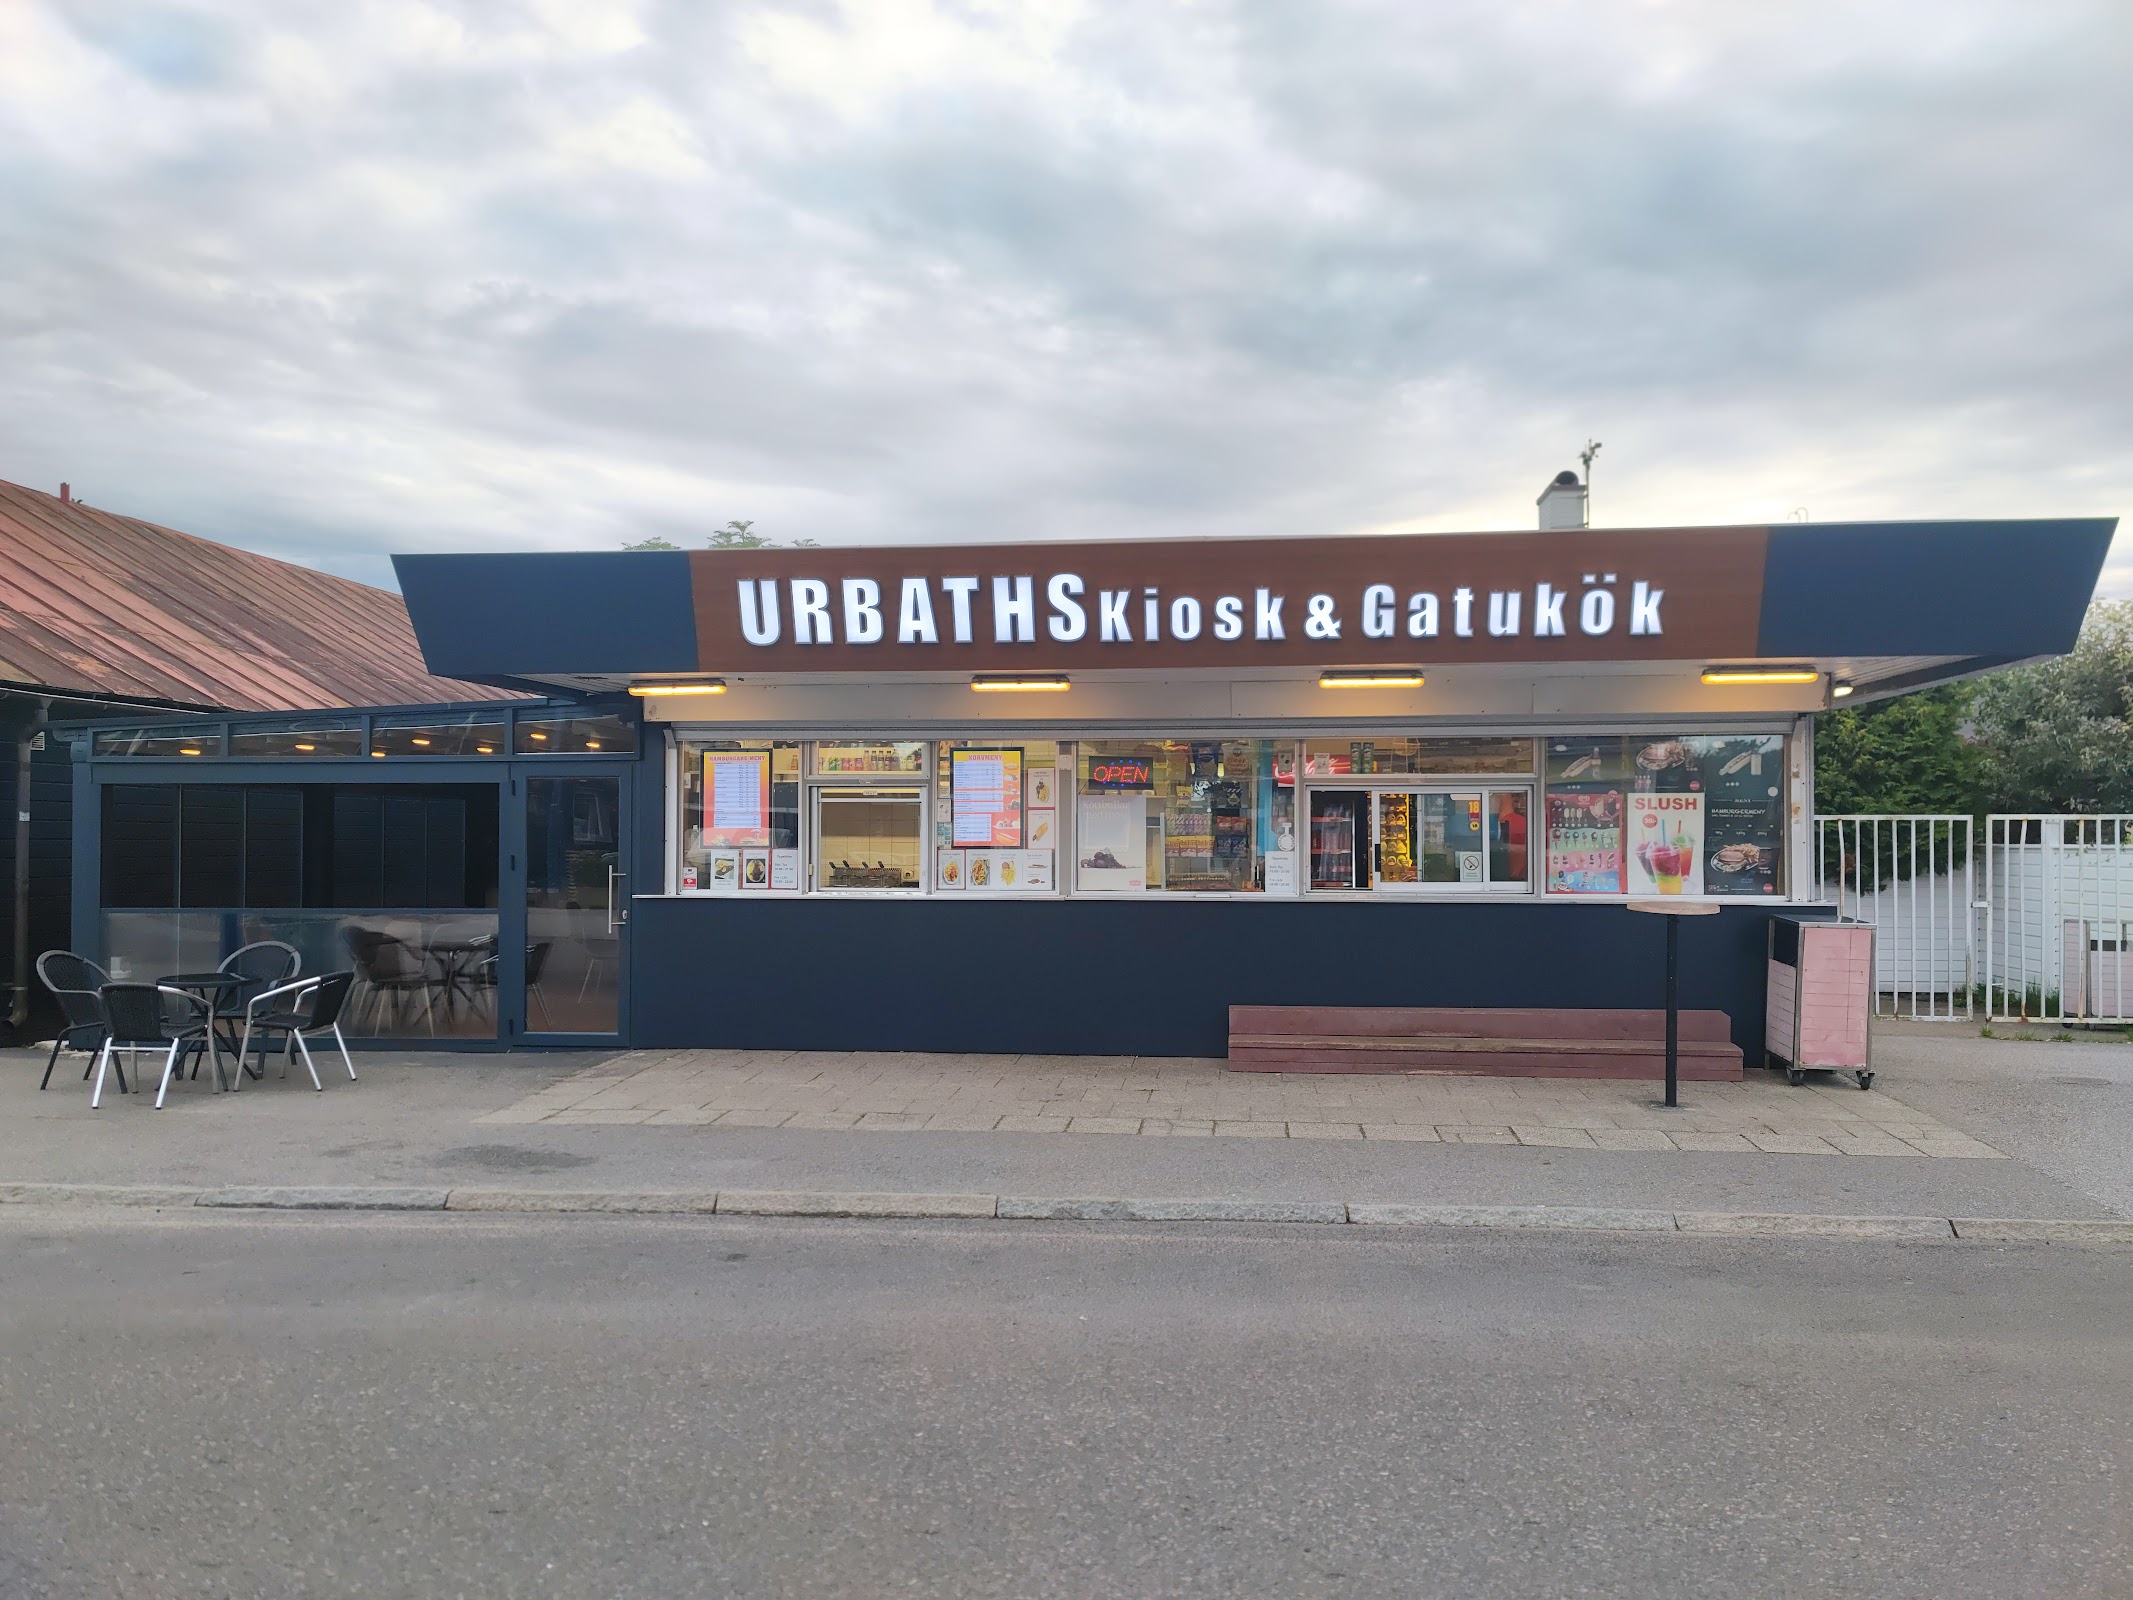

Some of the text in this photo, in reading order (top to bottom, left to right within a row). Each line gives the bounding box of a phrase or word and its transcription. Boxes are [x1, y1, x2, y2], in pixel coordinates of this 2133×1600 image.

[737, 572, 1666, 647] URBATHS Kiosk & Gatukök
[1093, 765, 1149, 783] OPEN
[1468, 800, 1480, 813] 18
[1634, 797, 1698, 811] SLUSH
